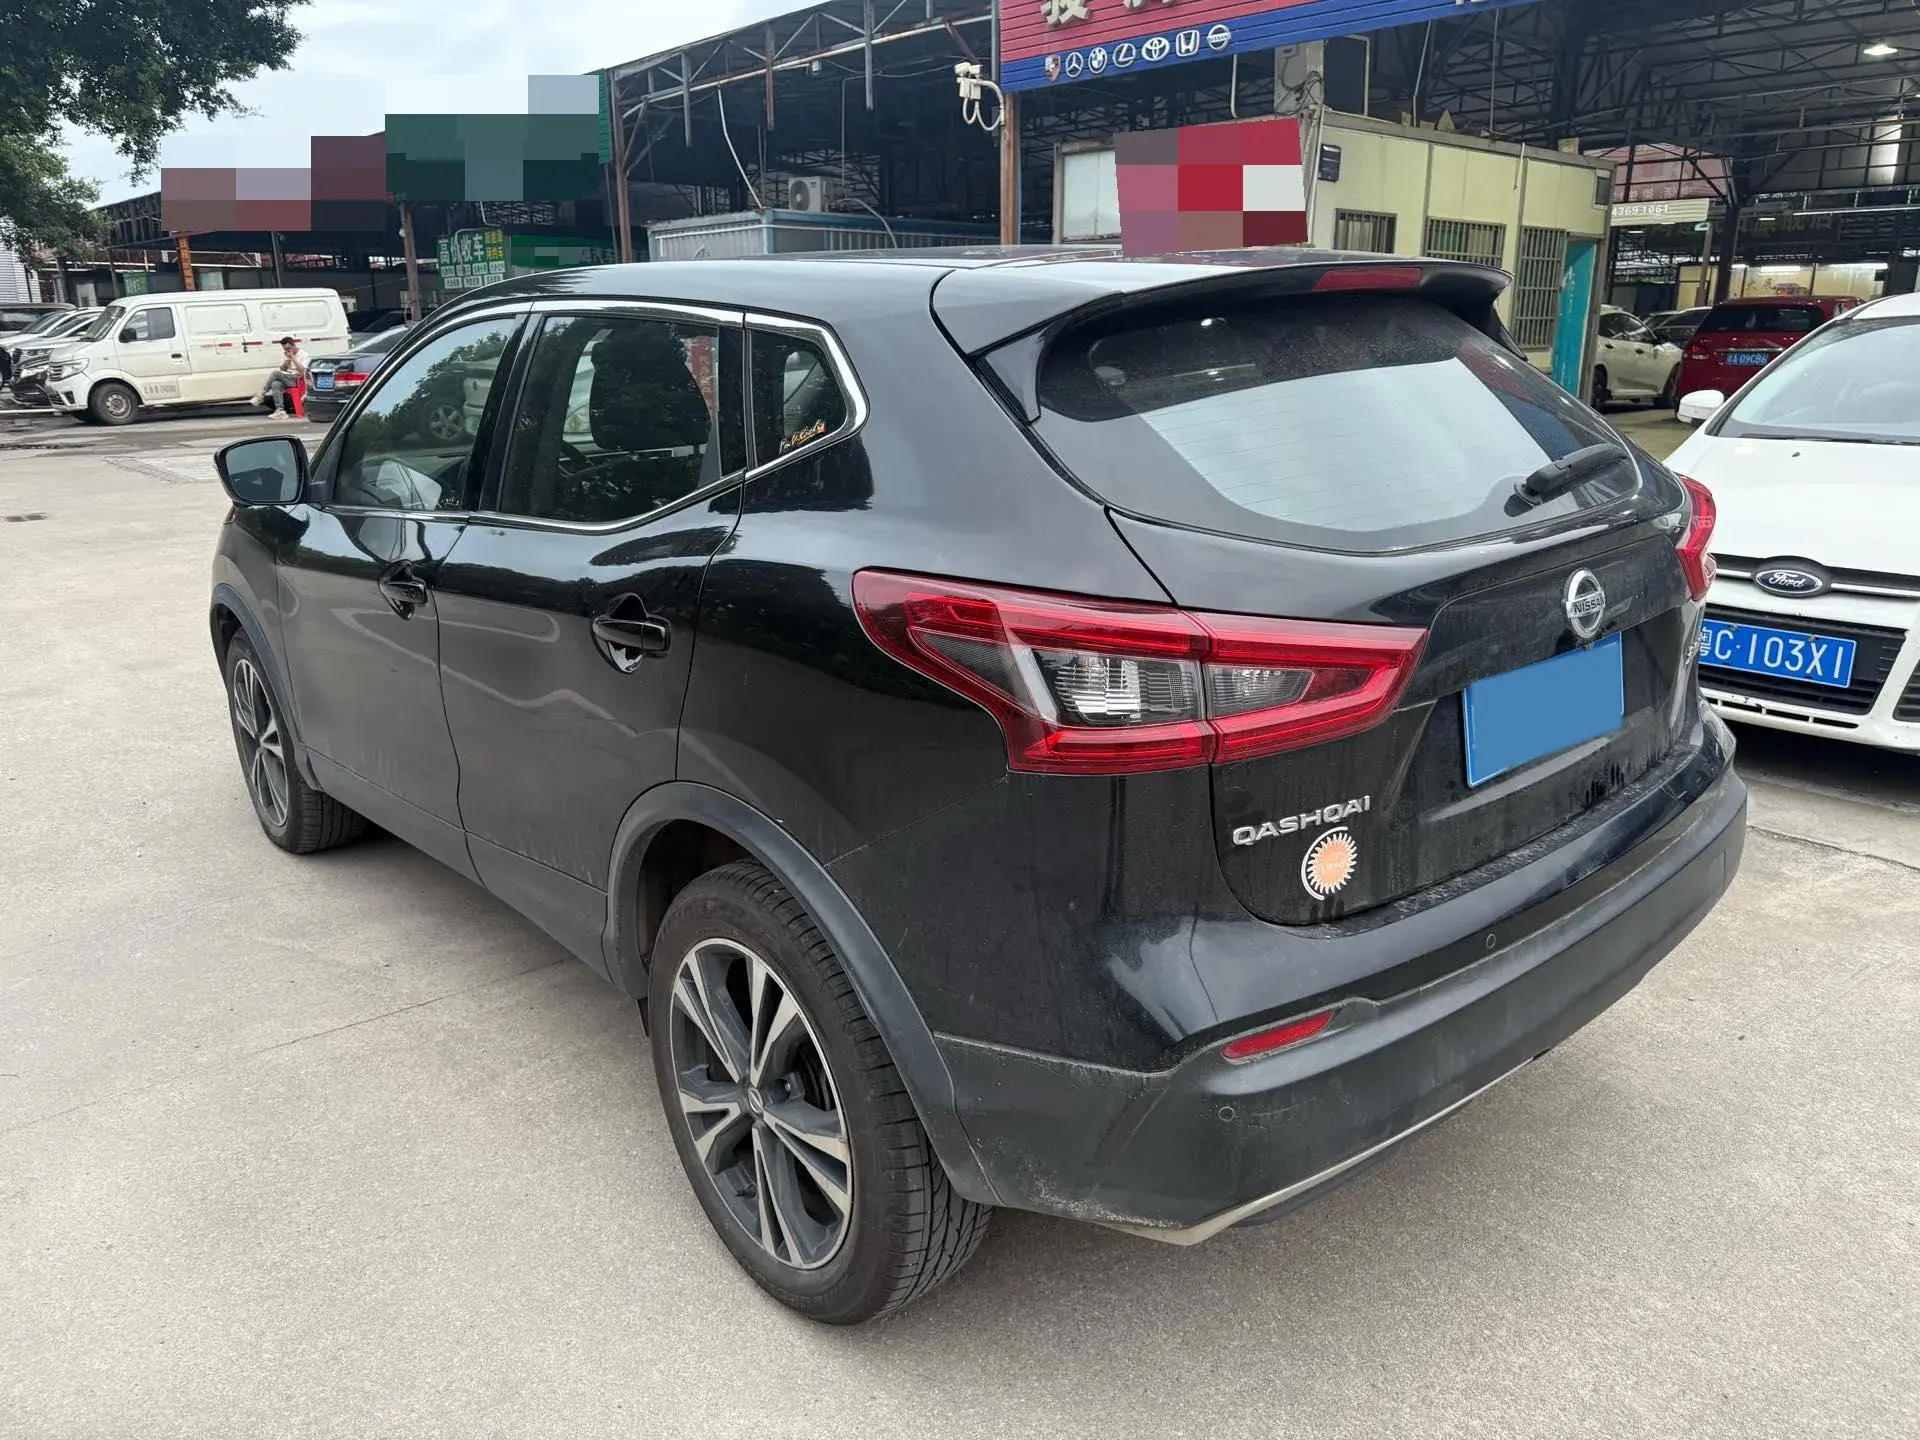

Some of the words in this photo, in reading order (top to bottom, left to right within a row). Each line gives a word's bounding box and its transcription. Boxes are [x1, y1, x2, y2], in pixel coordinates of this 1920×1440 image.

[1768, 572, 1806, 588] Ford
[1573, 596, 1605, 614] NISSAN
[1232, 795, 1371, 846] QASHQAI
